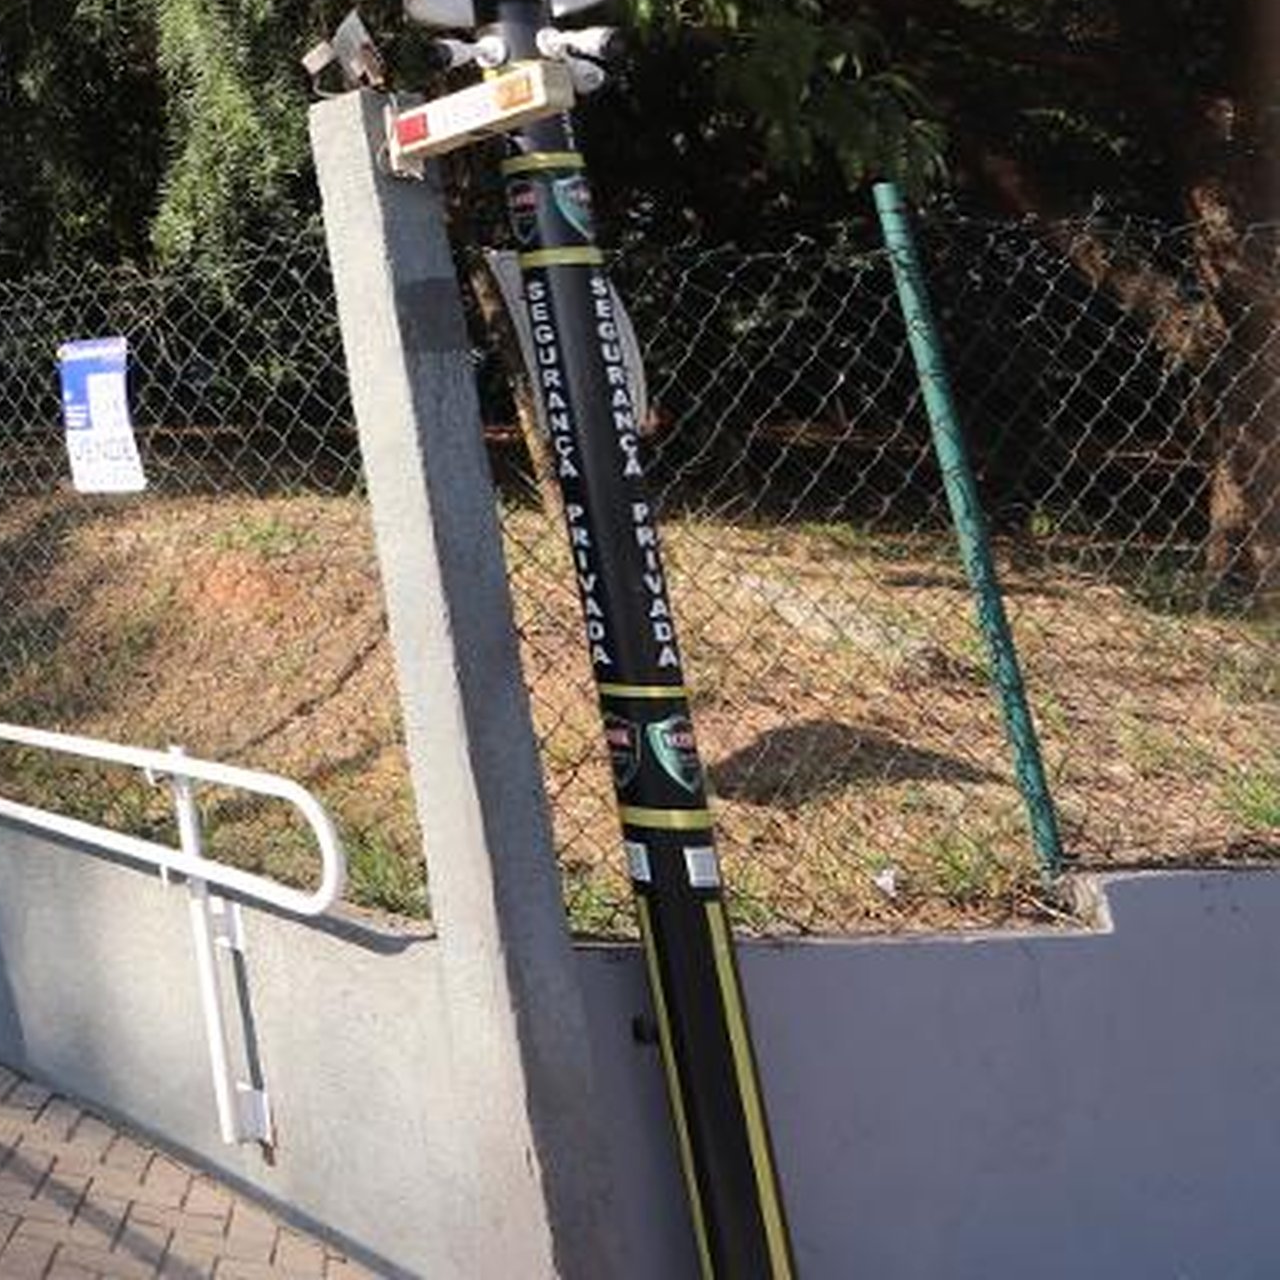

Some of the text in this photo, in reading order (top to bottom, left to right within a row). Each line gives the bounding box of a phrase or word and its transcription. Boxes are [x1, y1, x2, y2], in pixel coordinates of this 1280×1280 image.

[526, 280, 613, 666] SEGURANÇA PRIVADA
[588, 276, 678, 667] SEGURANÇA PRIVADA
